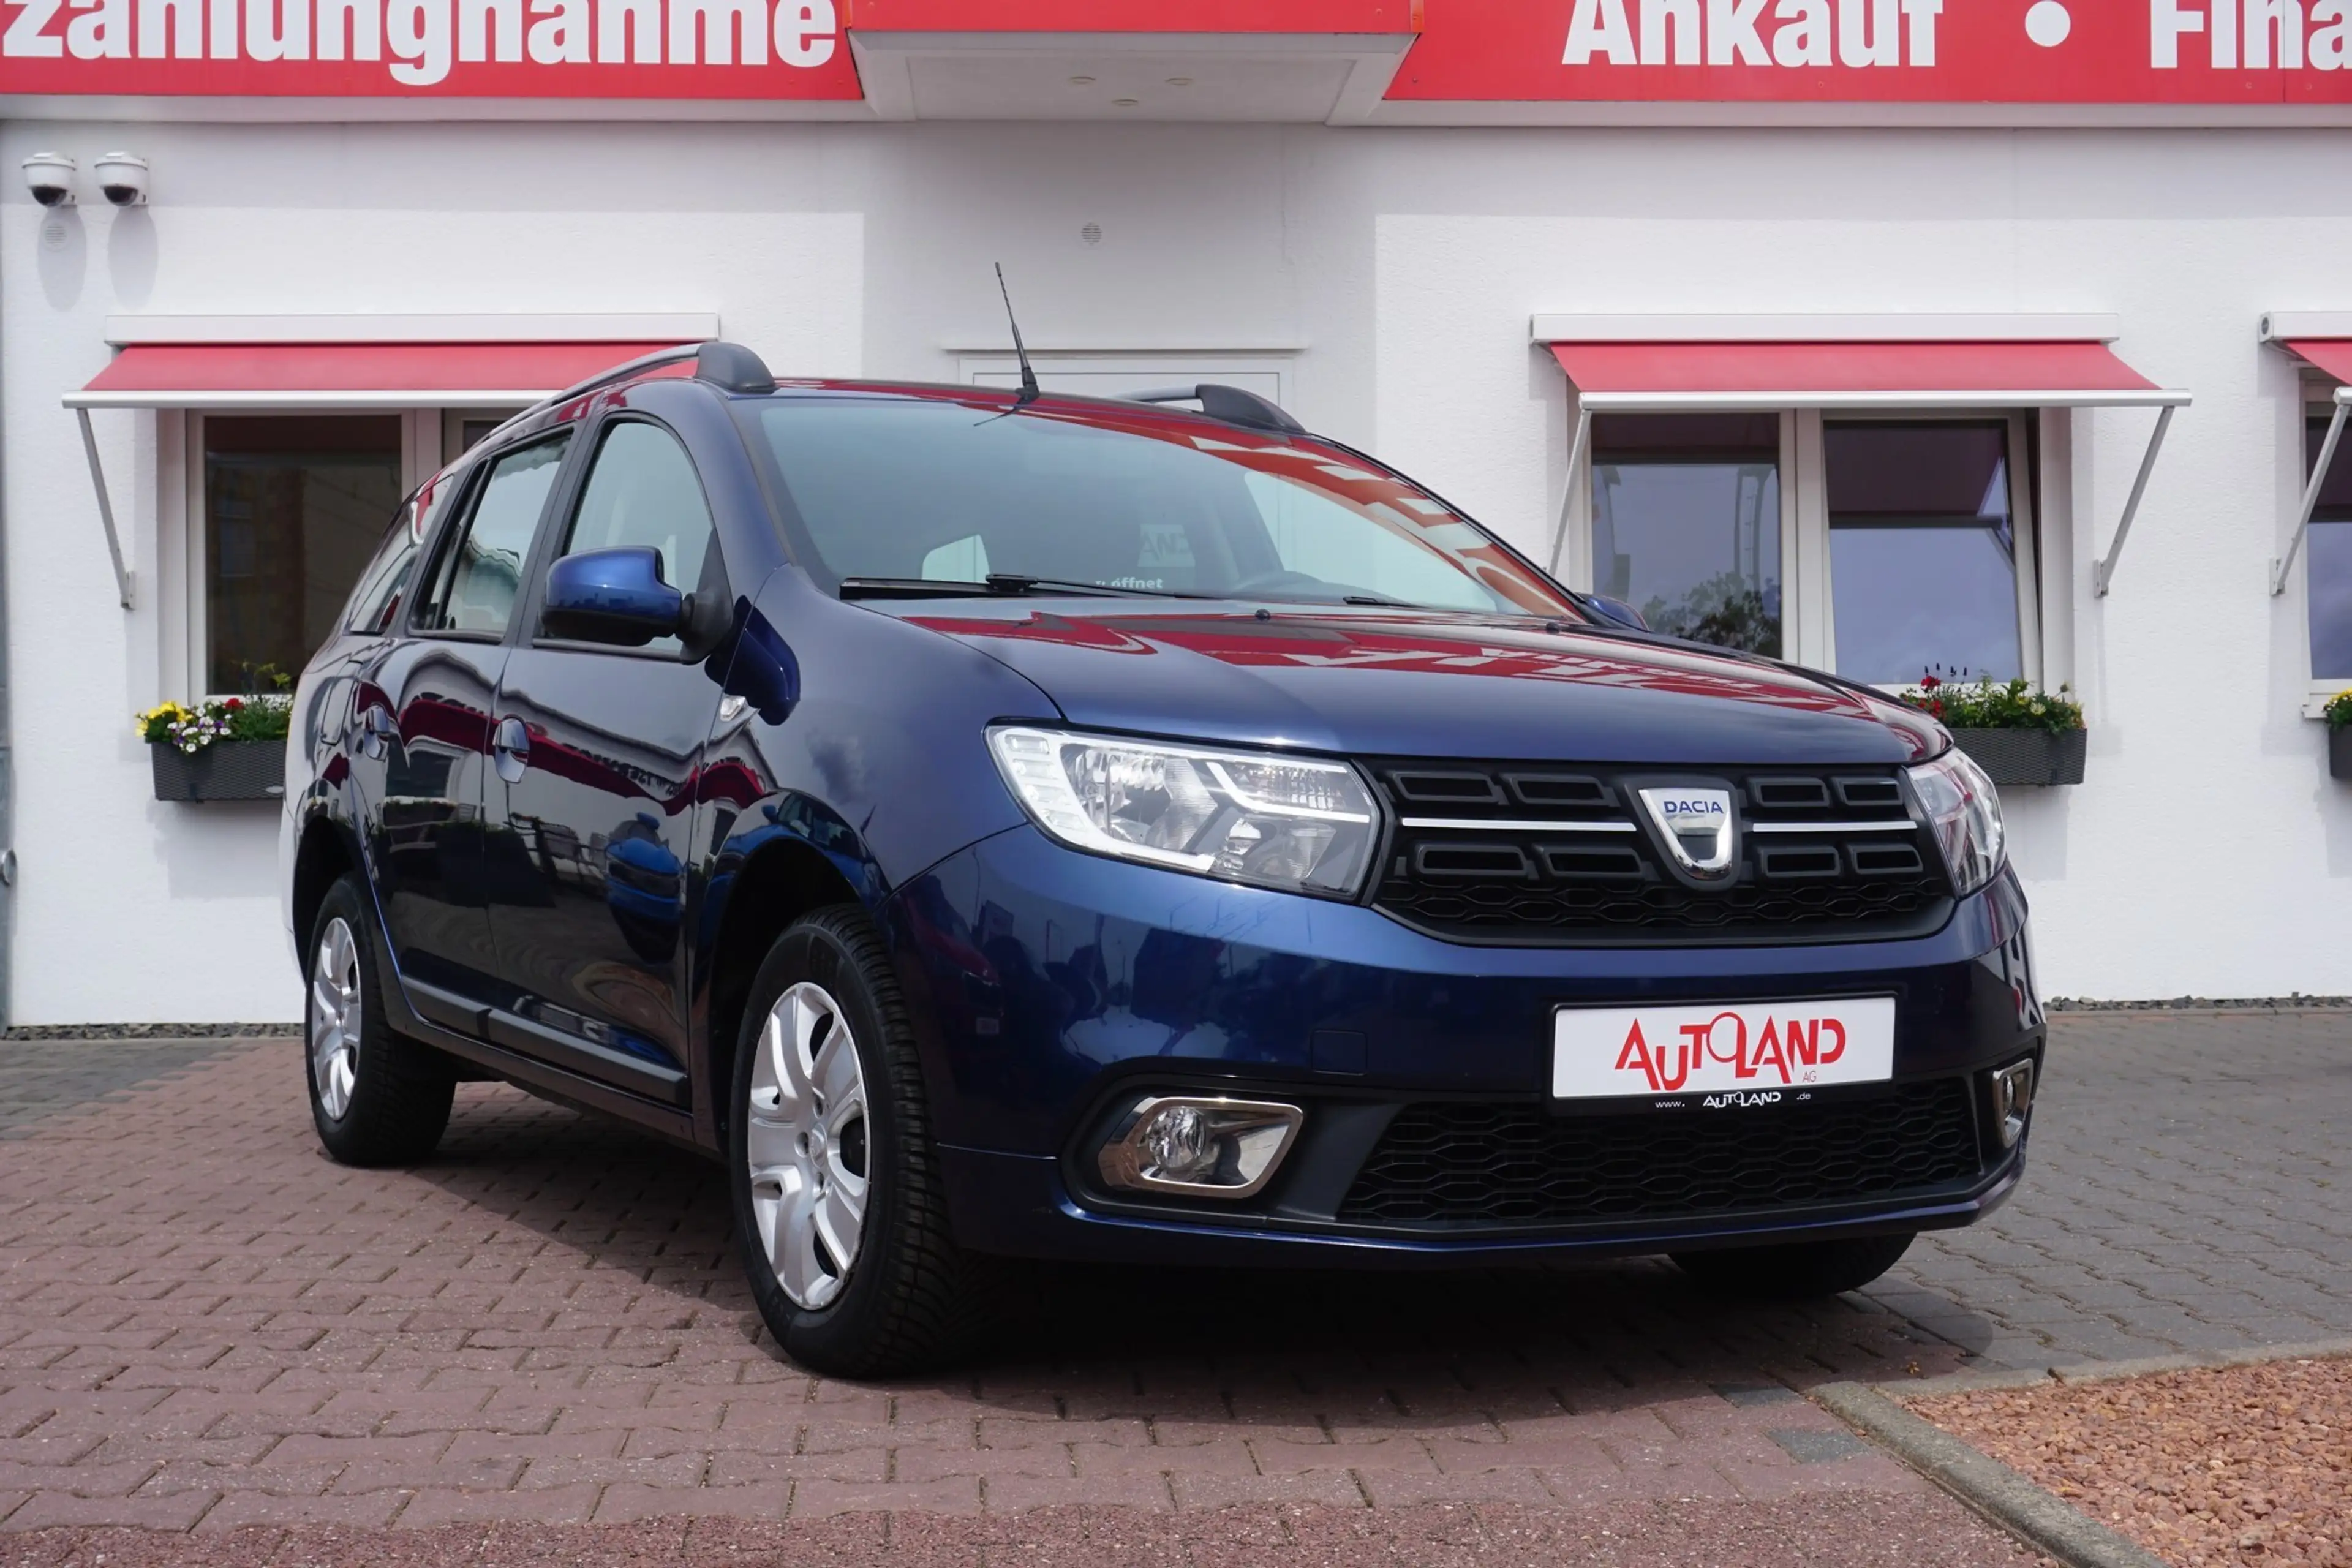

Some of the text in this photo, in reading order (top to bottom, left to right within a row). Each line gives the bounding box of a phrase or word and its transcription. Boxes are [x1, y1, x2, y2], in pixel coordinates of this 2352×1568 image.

[1561, 0, 1943, 68] Ankauf
[1664, 801, 1724, 814] DACIA
[1803, 1070, 1817, 1084] AG
